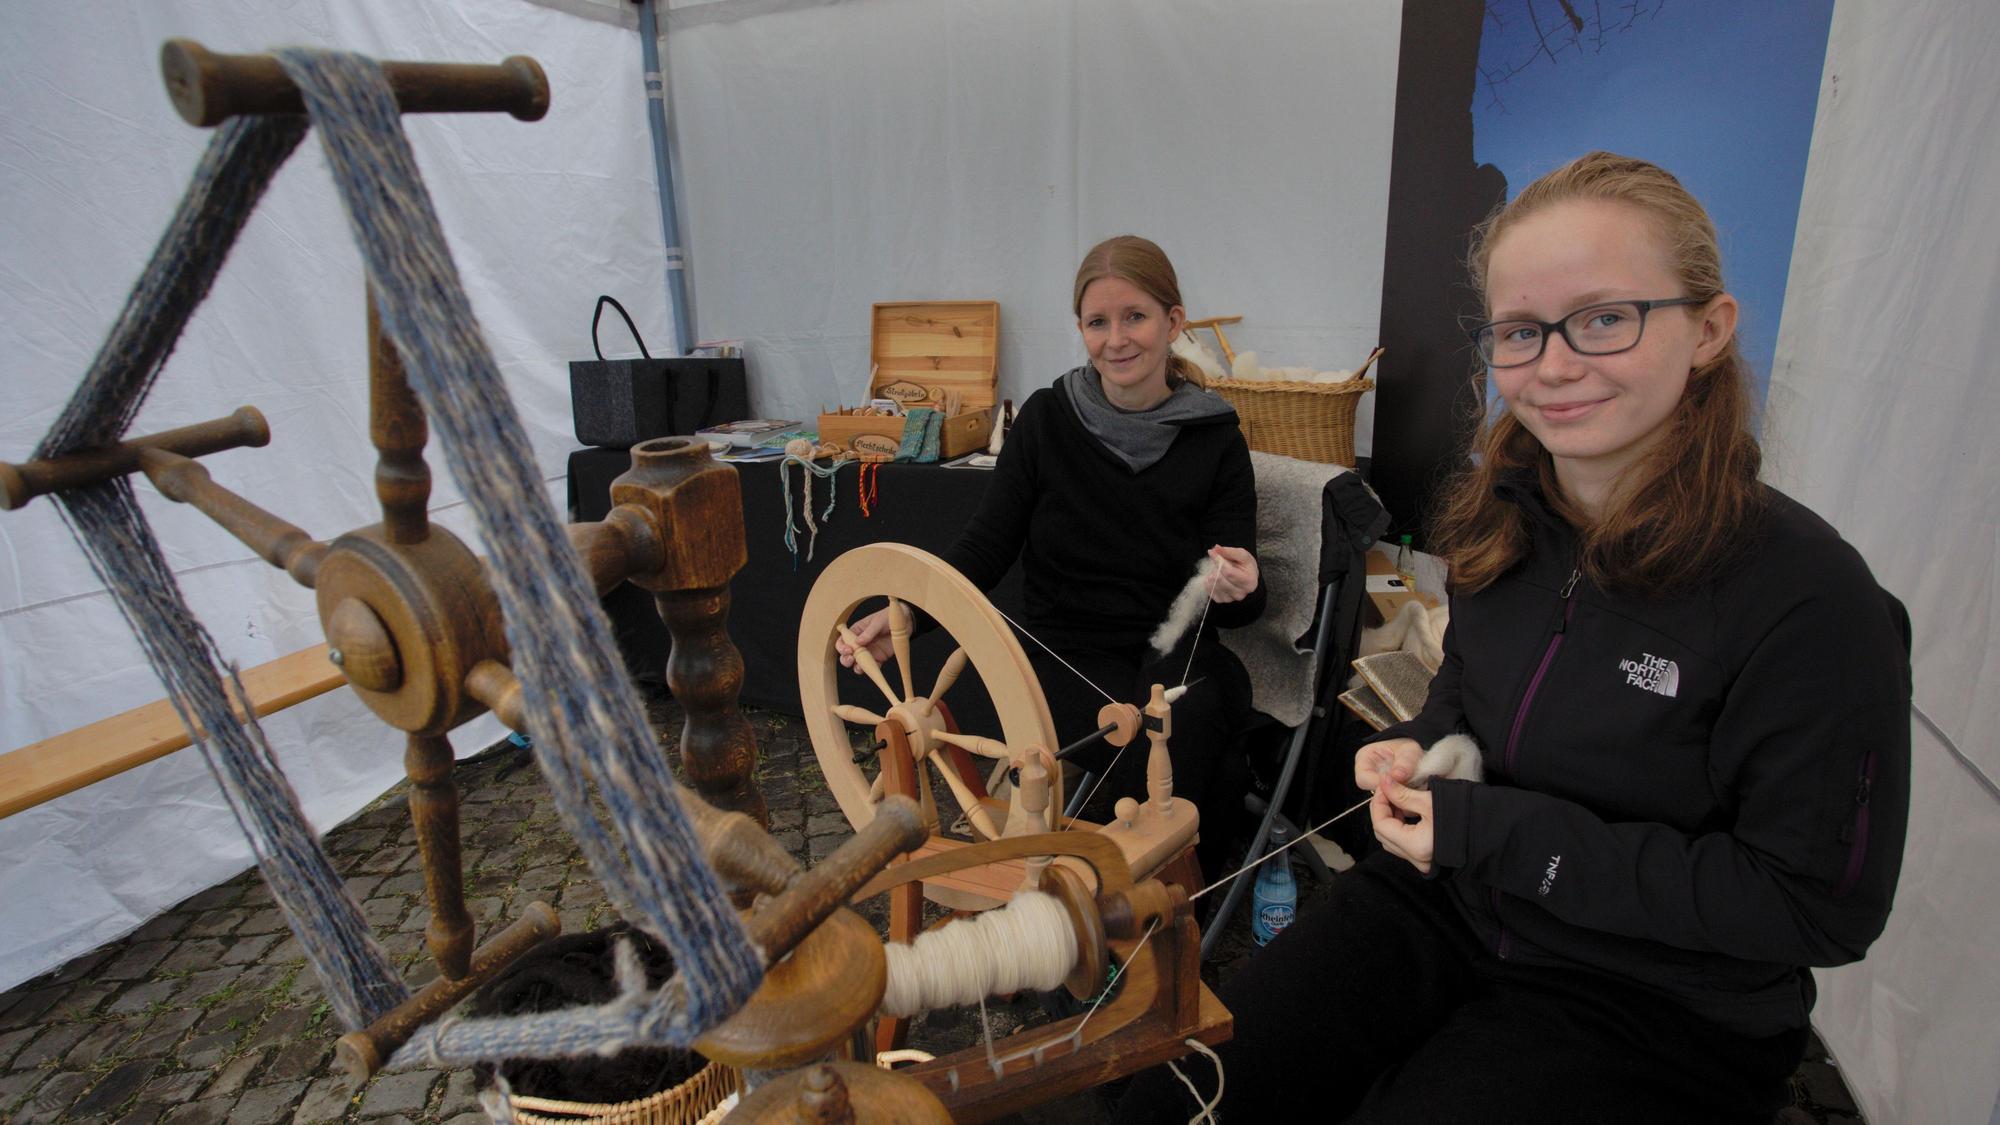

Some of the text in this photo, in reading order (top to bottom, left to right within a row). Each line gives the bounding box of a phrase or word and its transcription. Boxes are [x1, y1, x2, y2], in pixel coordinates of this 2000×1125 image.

[1618, 658, 1661, 681] NORTH
[1642, 652, 1669, 671] THE
[1626, 673, 1659, 693] FACE
